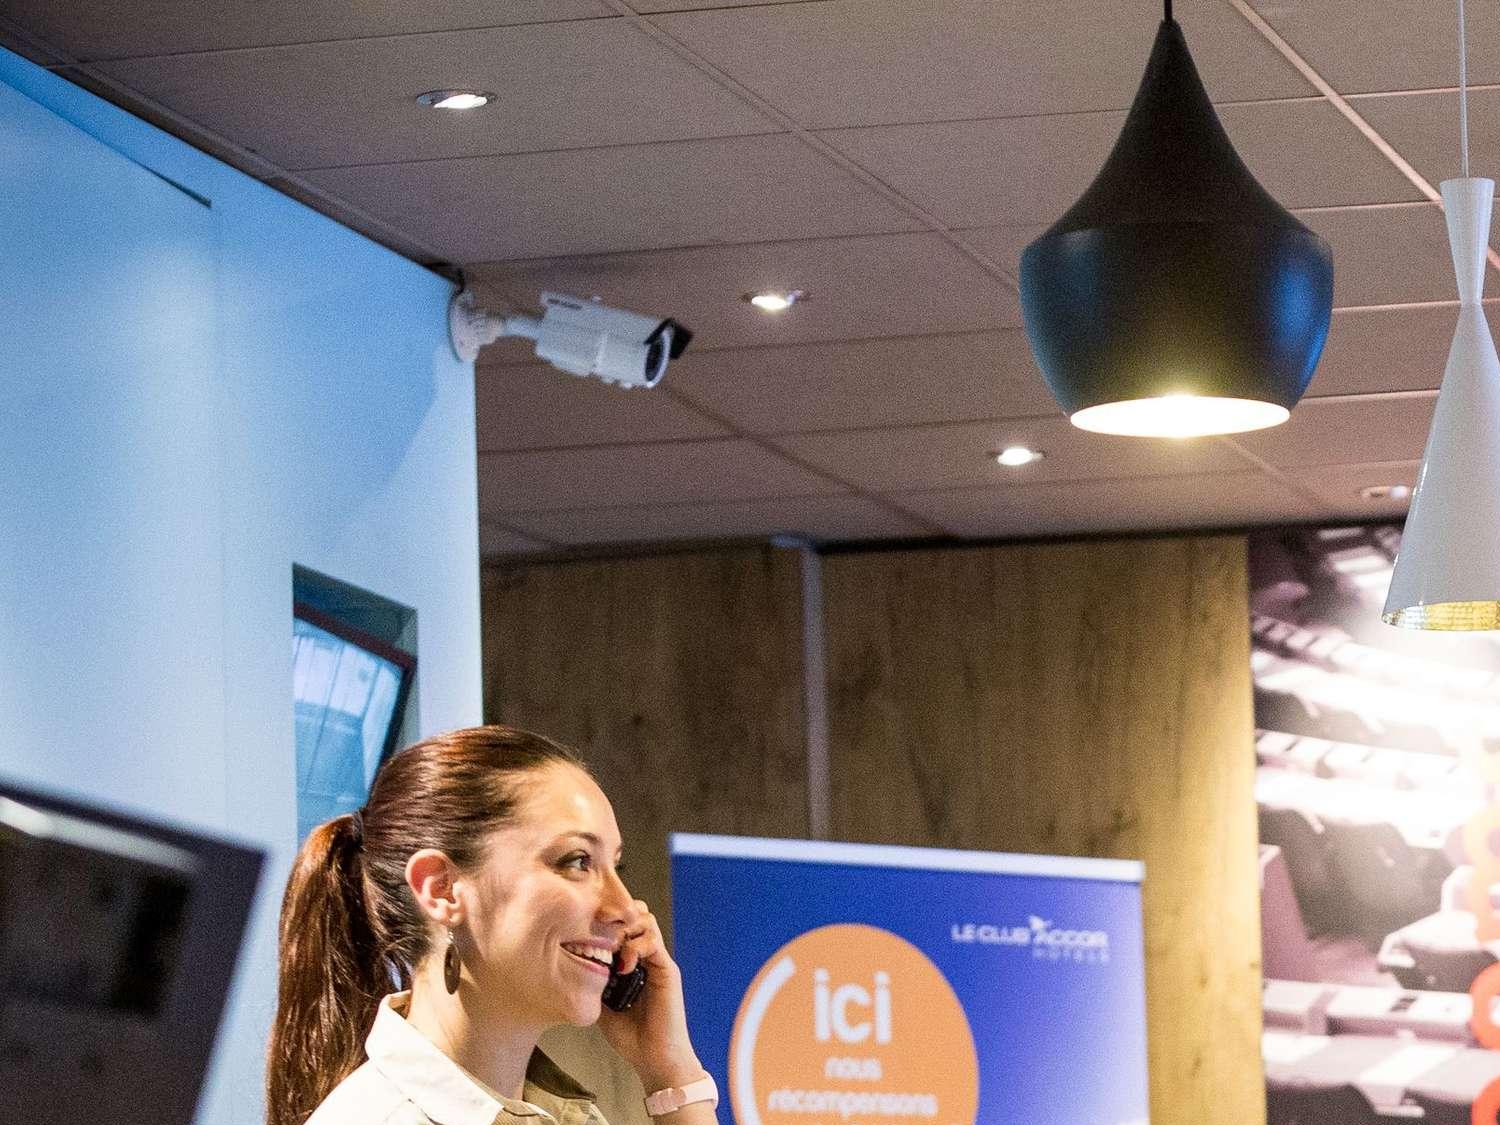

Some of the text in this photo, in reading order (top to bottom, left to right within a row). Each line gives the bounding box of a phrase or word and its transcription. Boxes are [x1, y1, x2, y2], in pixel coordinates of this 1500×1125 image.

[951, 923, 976, 944] LE
[976, 925, 1031, 946] CLUB
[813, 966, 892, 1044] ici
[825, 1056, 882, 1081] nous
